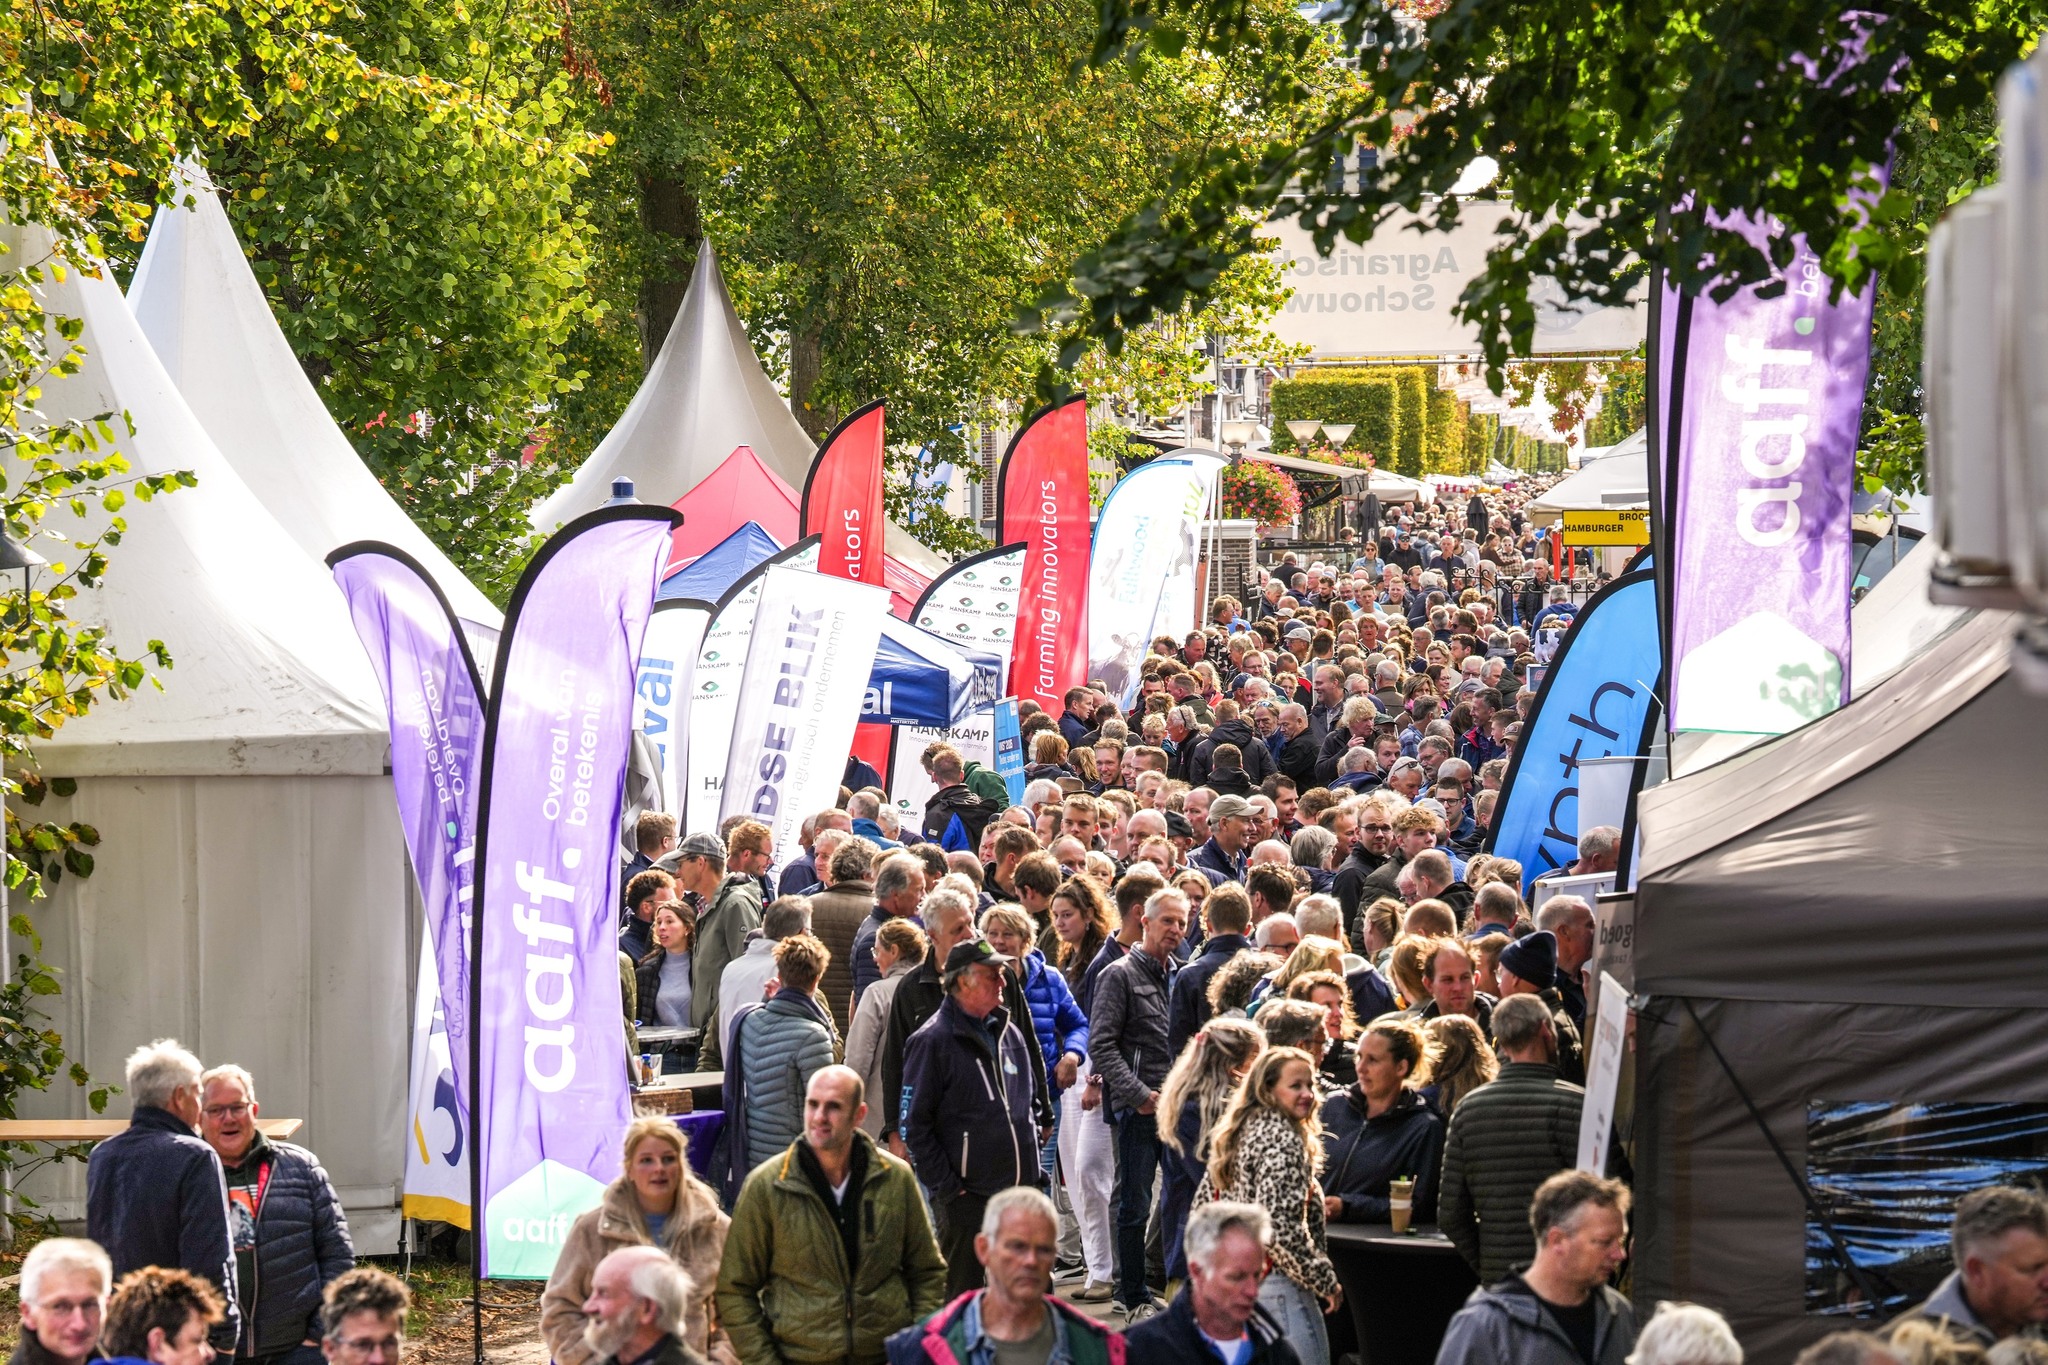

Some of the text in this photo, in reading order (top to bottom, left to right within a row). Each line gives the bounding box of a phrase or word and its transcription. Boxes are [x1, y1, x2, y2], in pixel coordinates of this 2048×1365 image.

[1564, 524, 1624, 532] HAMBURGER
[1619, 513, 1650, 521] BROO
[953, 580, 984, 588] HANSKAMP
[1034, 480, 1061, 700] farming innovators
[949, 606, 981, 615] HANSKAMP
[946, 632, 977, 640] HANSKAMP
[773, 604, 825, 708] BLIK
[812, 610, 846, 713] ondernemen
[542, 668, 577, 821] Overal van
[565, 690, 601, 827] betekenis
[503, 1212, 568, 1244] aaff
